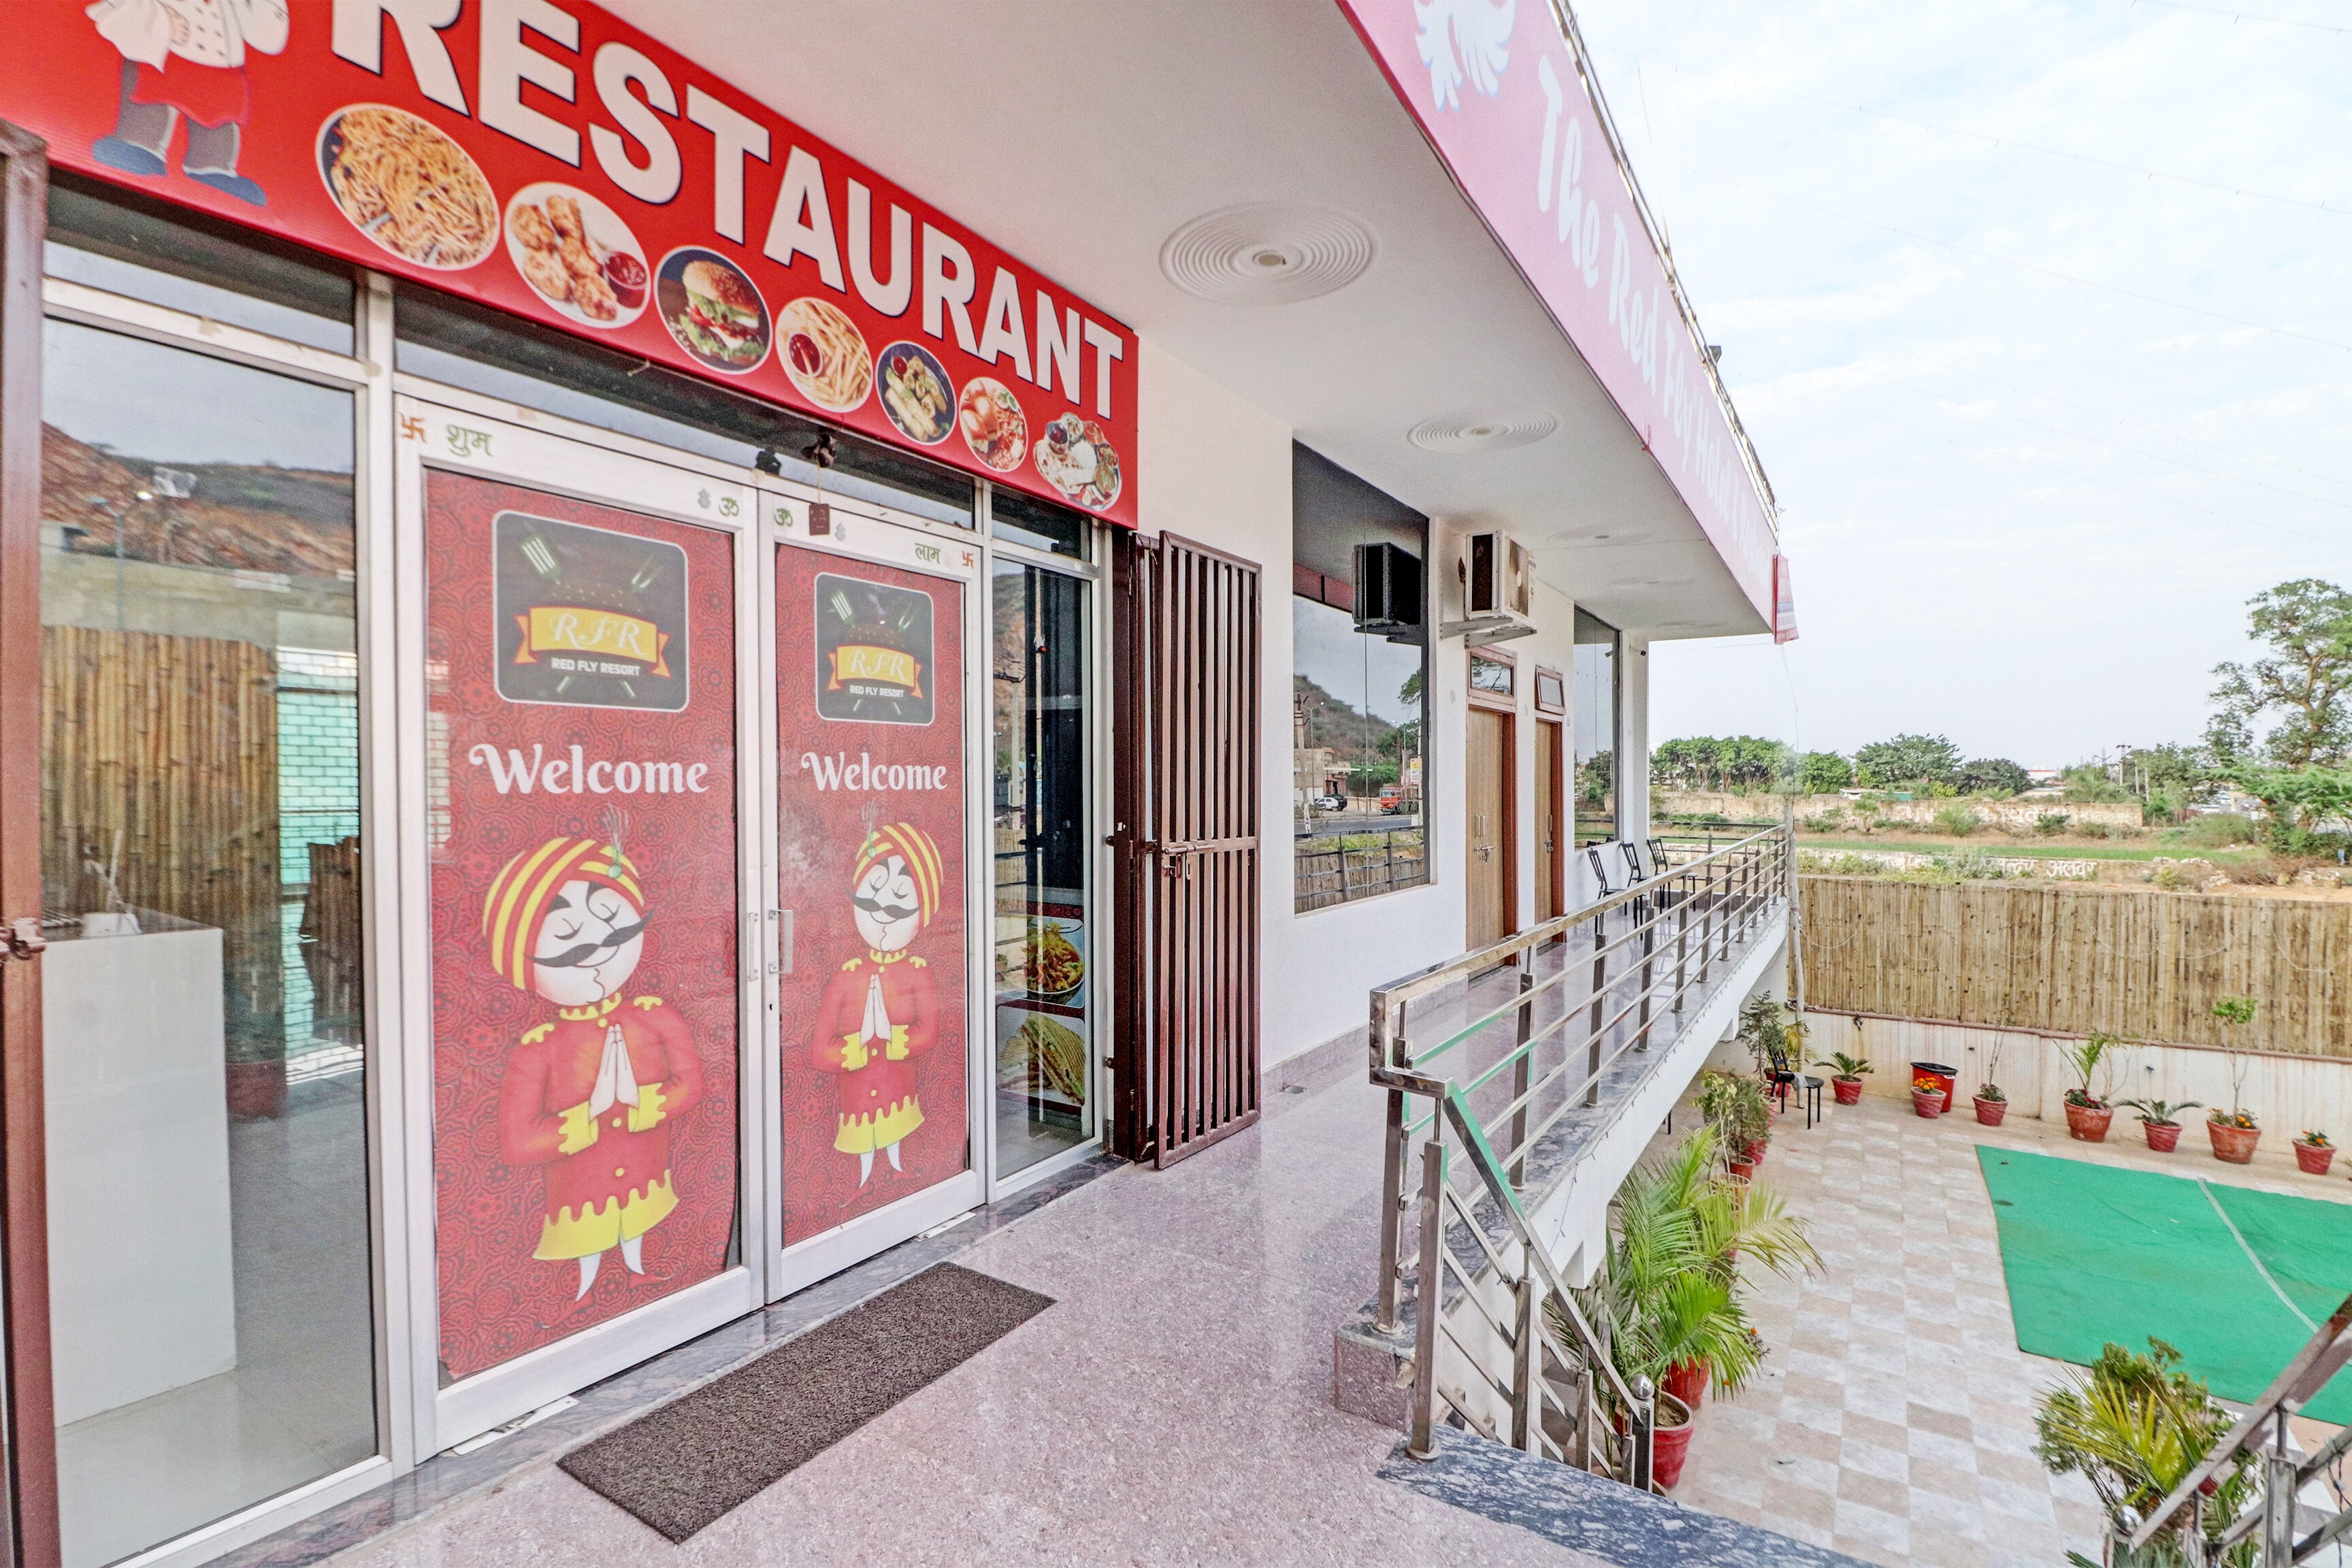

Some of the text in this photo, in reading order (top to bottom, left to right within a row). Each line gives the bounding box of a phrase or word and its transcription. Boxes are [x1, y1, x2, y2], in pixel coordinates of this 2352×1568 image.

[331, 0, 1124, 421] RESTAURANT
[1537, 53, 1601, 289] The
[1608, 212, 1658, 397] Red
[551, 657, 641, 676] RED FLY RESORT
[849, 685, 904, 698] RED FLY RESORT
[469, 744, 709, 796] Welcome
[801, 752, 948, 791] Welcome
